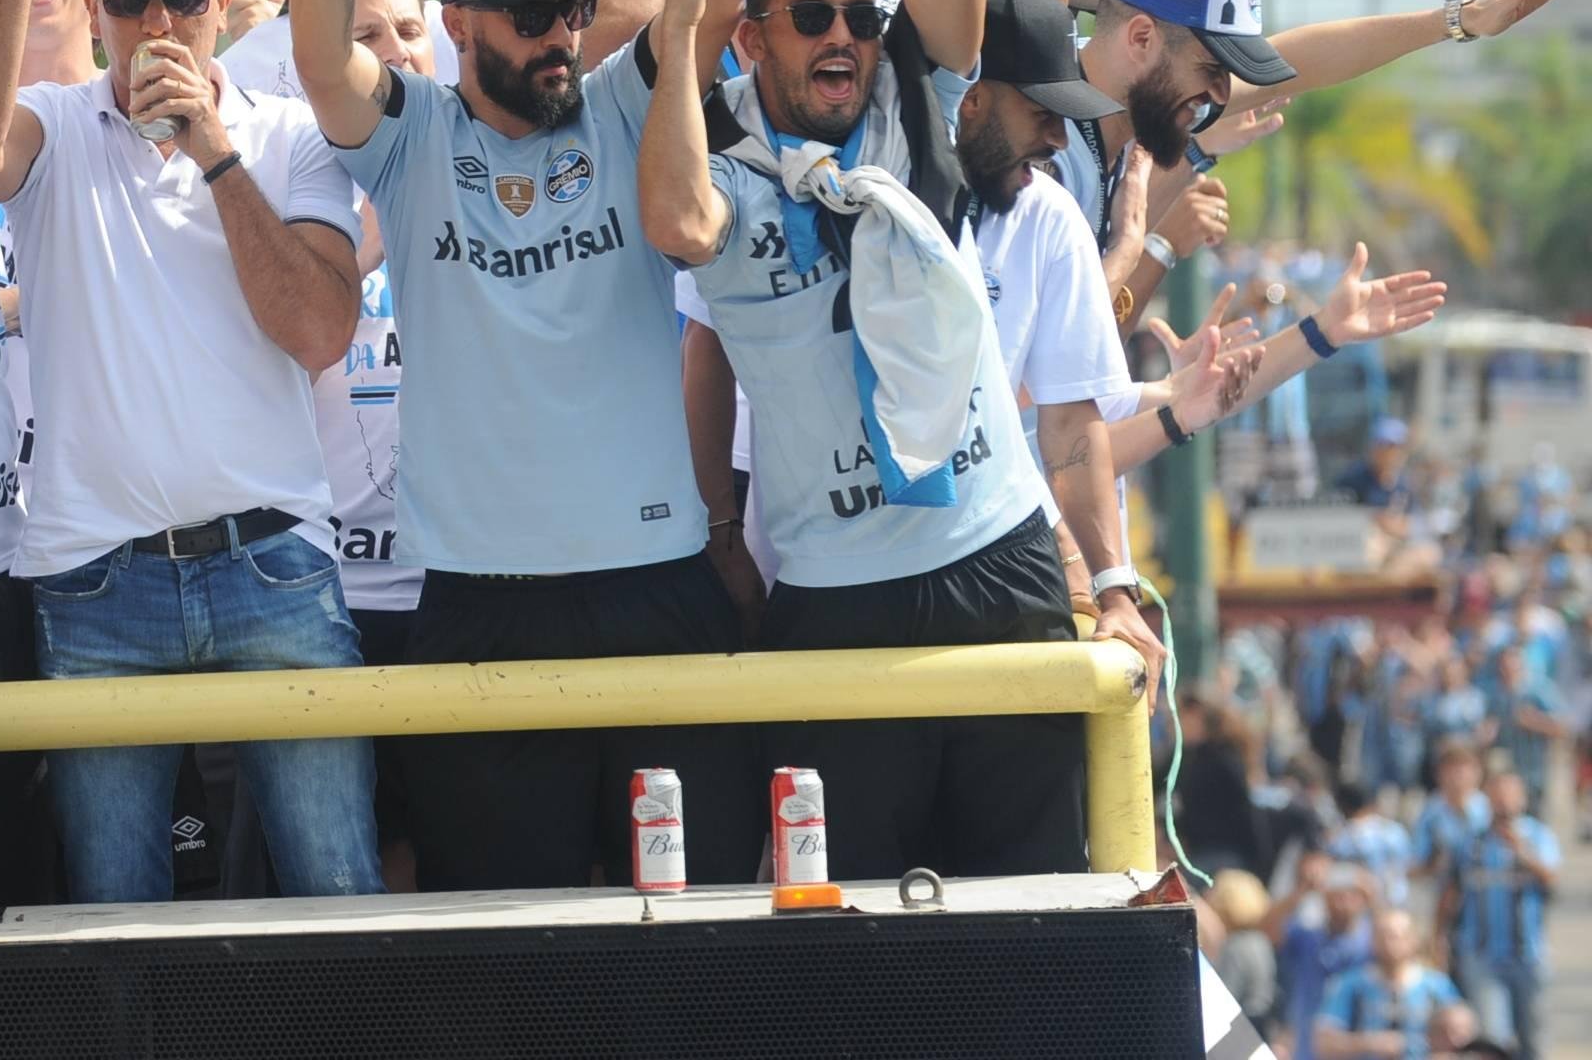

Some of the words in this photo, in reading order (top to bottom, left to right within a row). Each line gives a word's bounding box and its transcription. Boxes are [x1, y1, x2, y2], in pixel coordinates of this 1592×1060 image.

[548, 163, 588, 192] GRÊMIO
[467, 207, 625, 278] Banrisul
[174, 839, 206, 851] umbro
